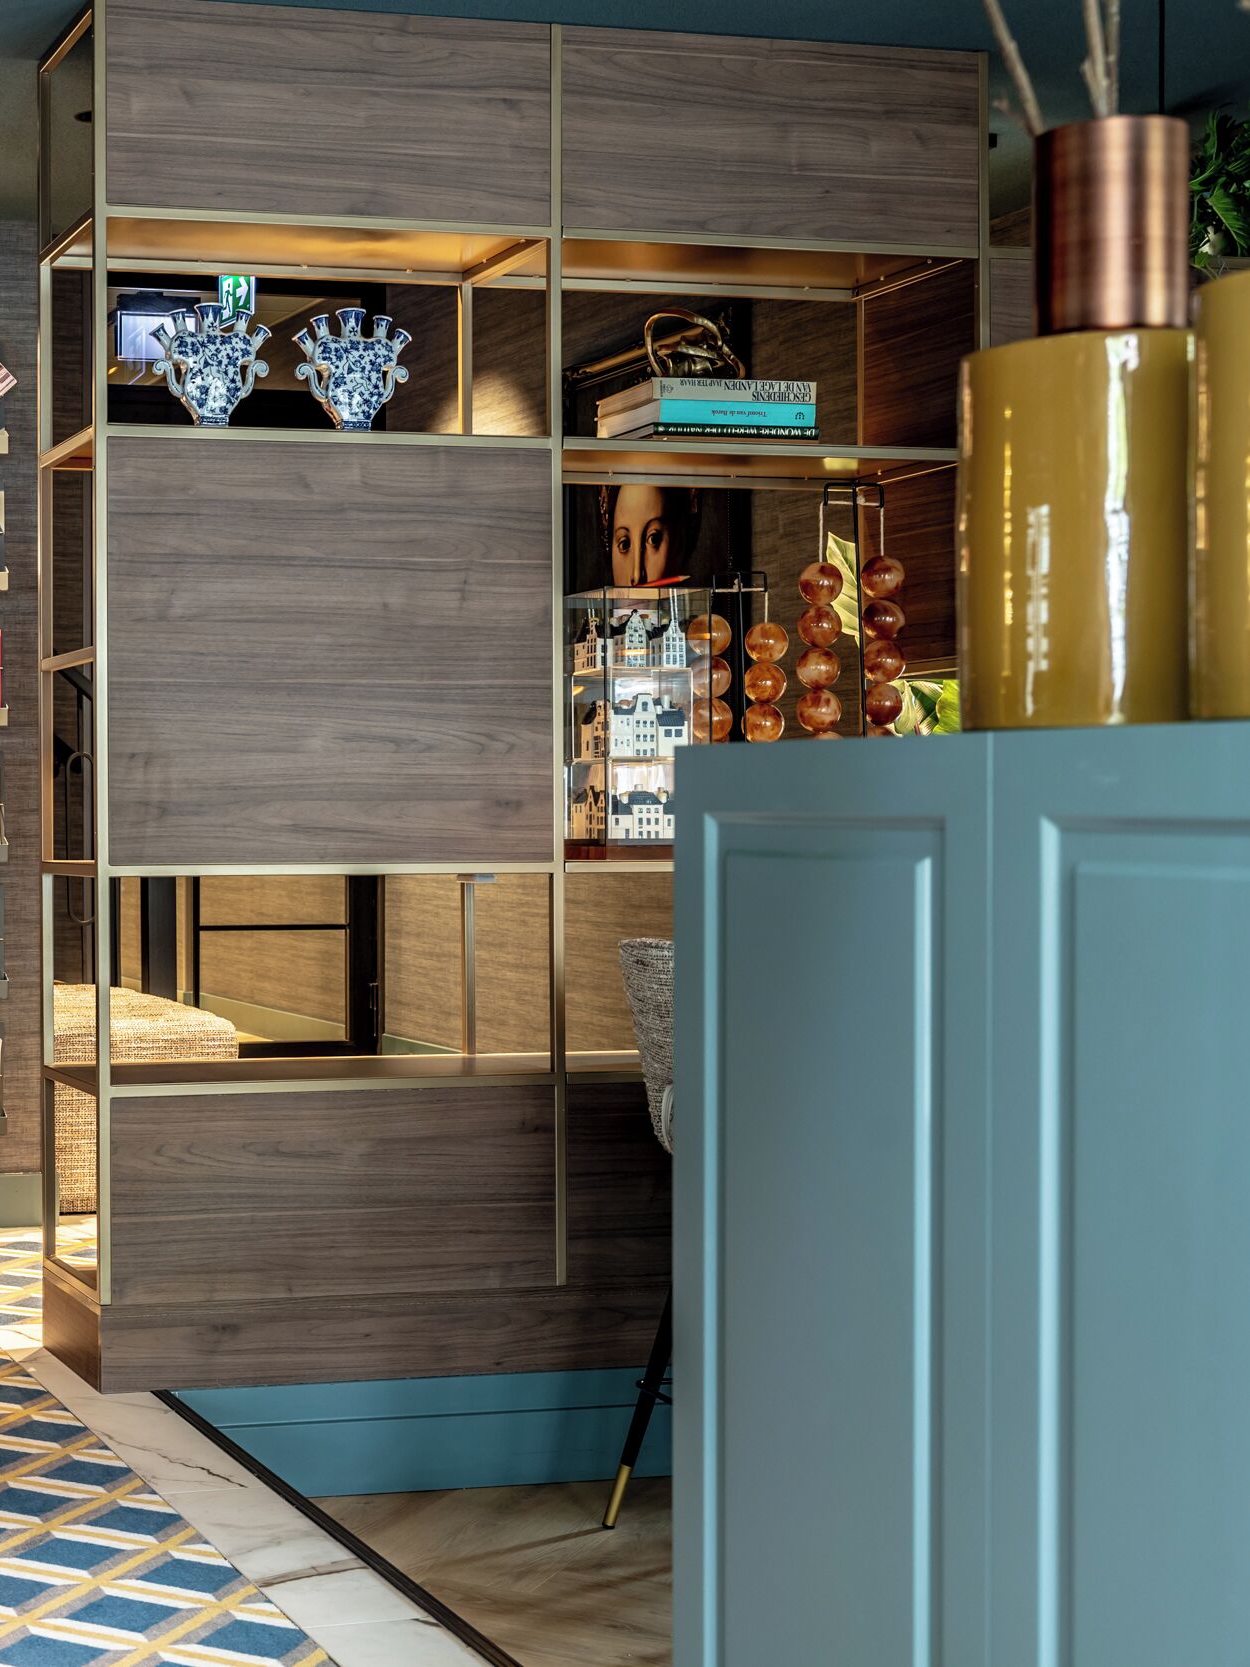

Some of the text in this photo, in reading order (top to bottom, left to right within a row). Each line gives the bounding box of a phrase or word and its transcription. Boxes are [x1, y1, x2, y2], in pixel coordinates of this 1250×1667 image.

[696, 379, 708, 387] TER
[708, 379, 722, 387] JAAP
[724, 380, 758, 391] LANDEN
[759, 381, 782, 391] LAGE
[784, 382, 795, 392] DE
[795, 382, 812, 392] VAN
[752, 391, 812, 402] GESCHIEDENIS
[759, 427, 802, 436] WONDERE
[804, 428, 816, 437] DE
